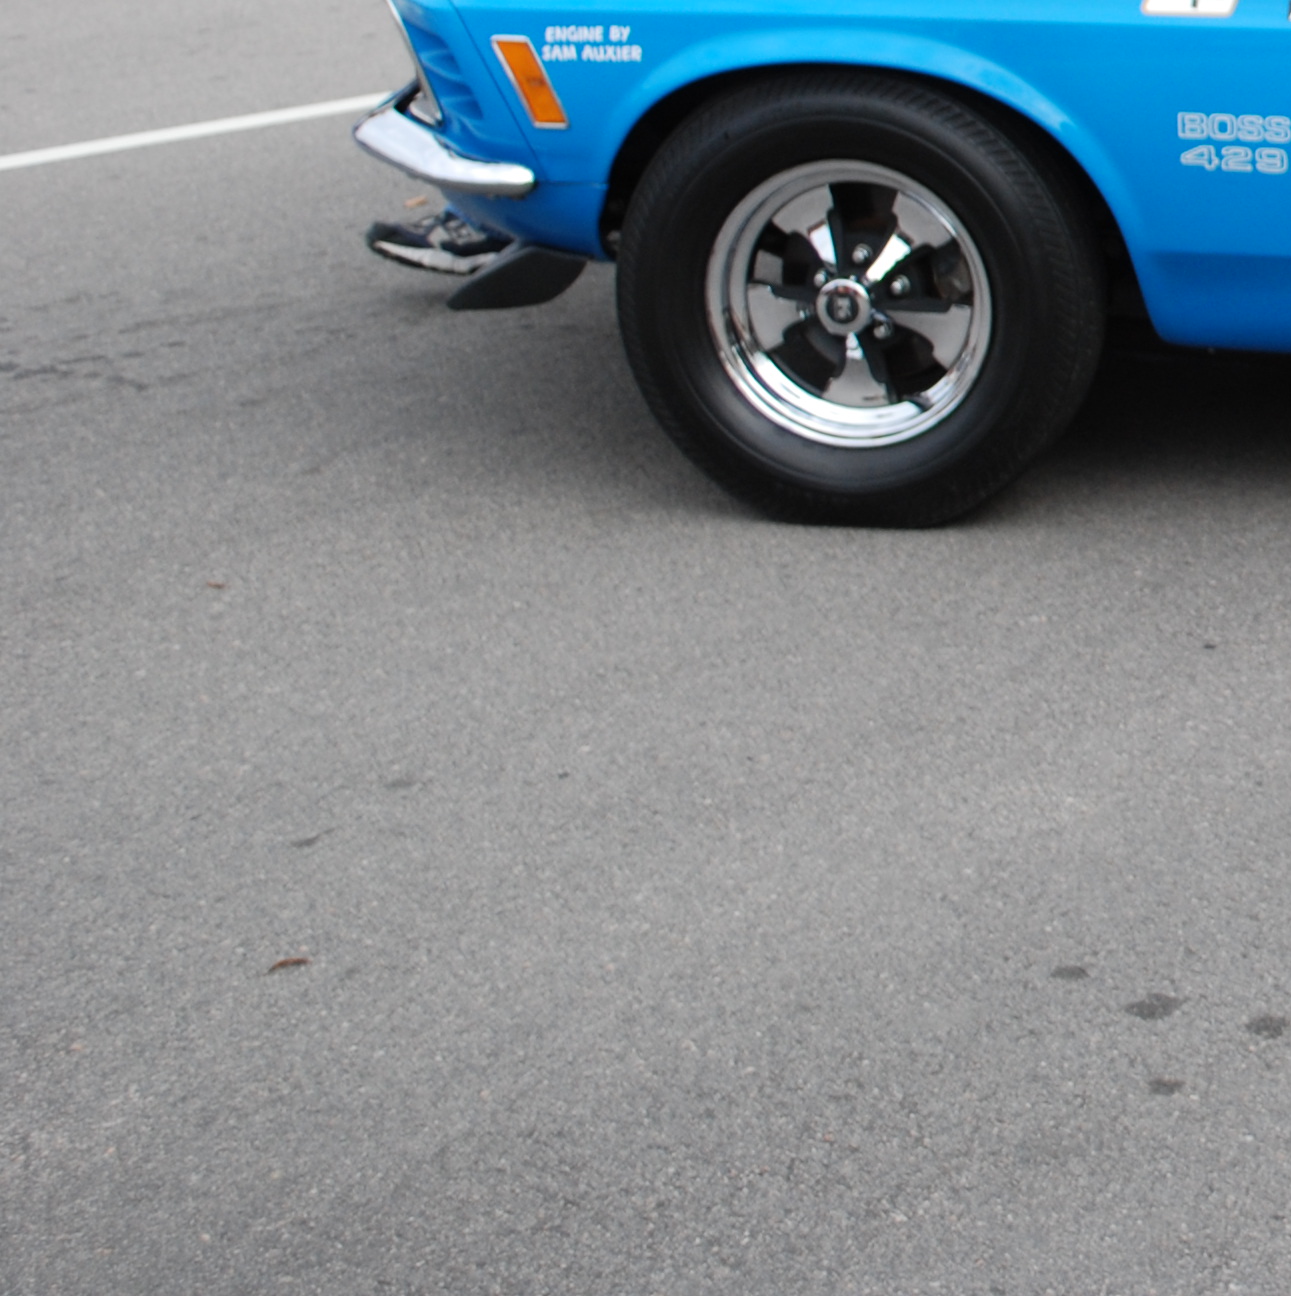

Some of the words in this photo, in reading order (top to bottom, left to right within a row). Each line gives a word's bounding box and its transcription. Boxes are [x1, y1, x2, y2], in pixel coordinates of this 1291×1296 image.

[544, 25, 604, 43] ENGINE
[609, 24, 631, 43] BY
[541, 44, 577, 62] SAM
[581, 44, 643, 62] AUXIER
[1180, 144, 1290, 174] 429
